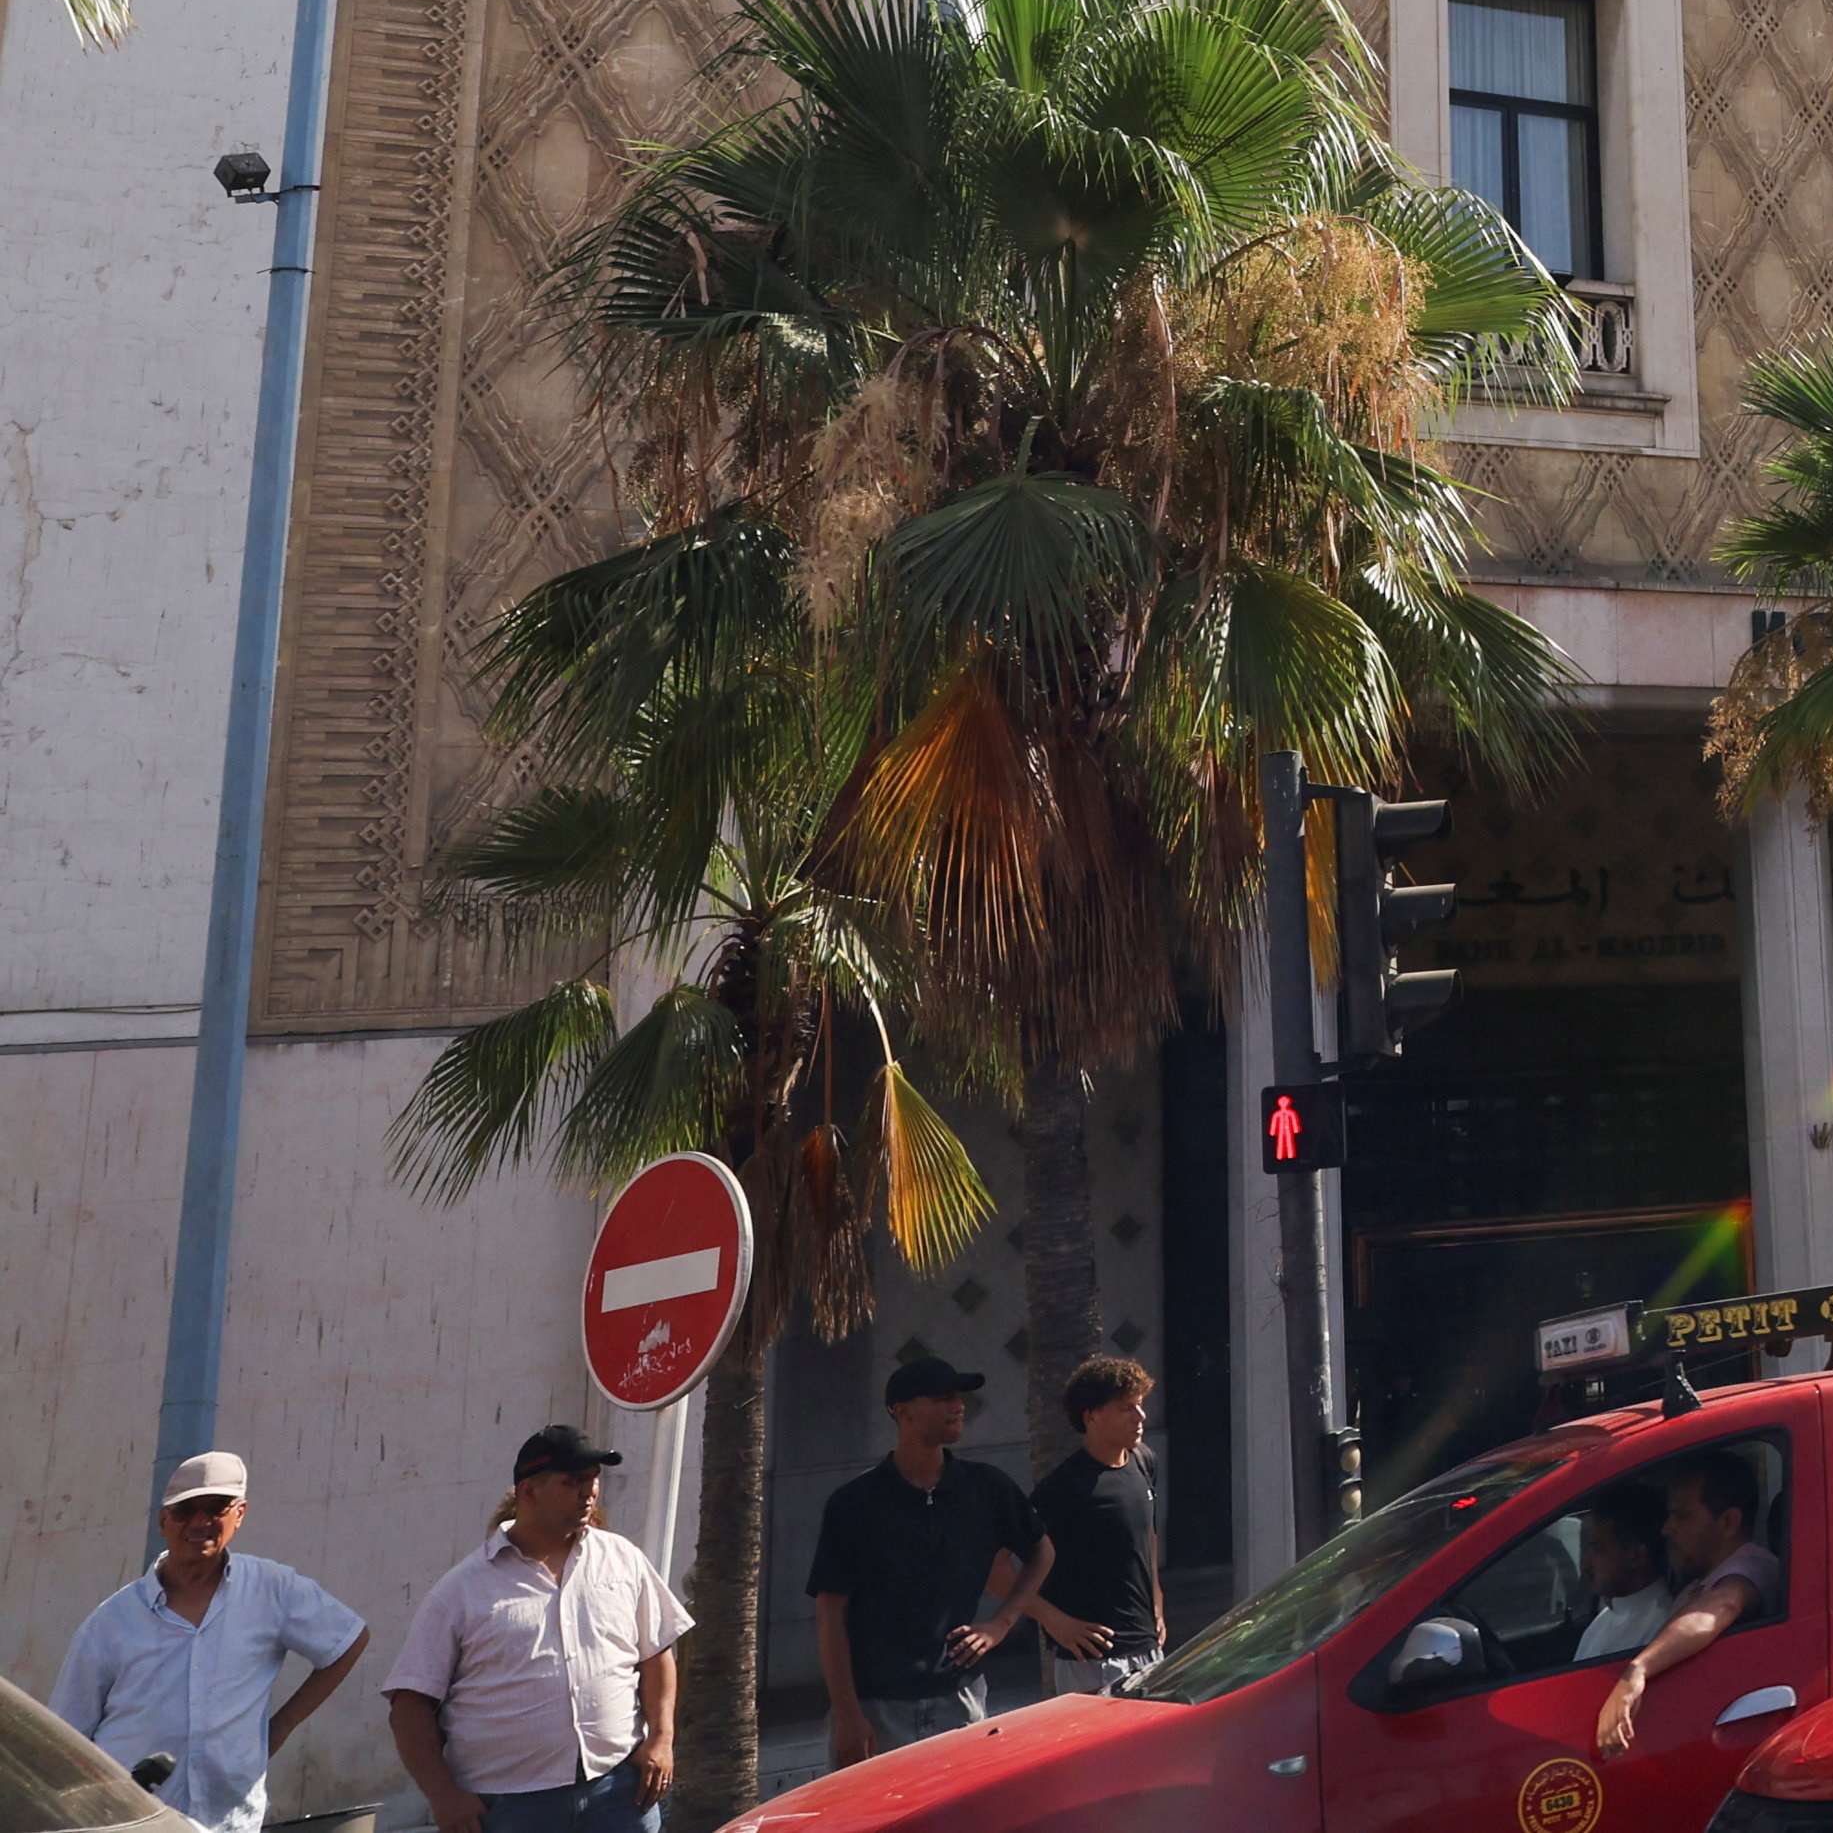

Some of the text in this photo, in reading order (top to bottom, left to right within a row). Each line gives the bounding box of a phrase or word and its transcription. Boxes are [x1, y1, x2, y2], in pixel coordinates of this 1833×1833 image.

[1458, 867, 1609, 911] المغ
[1666, 1298, 1798, 1347] PETIT
[1544, 1335, 1577, 1358] TAXI
